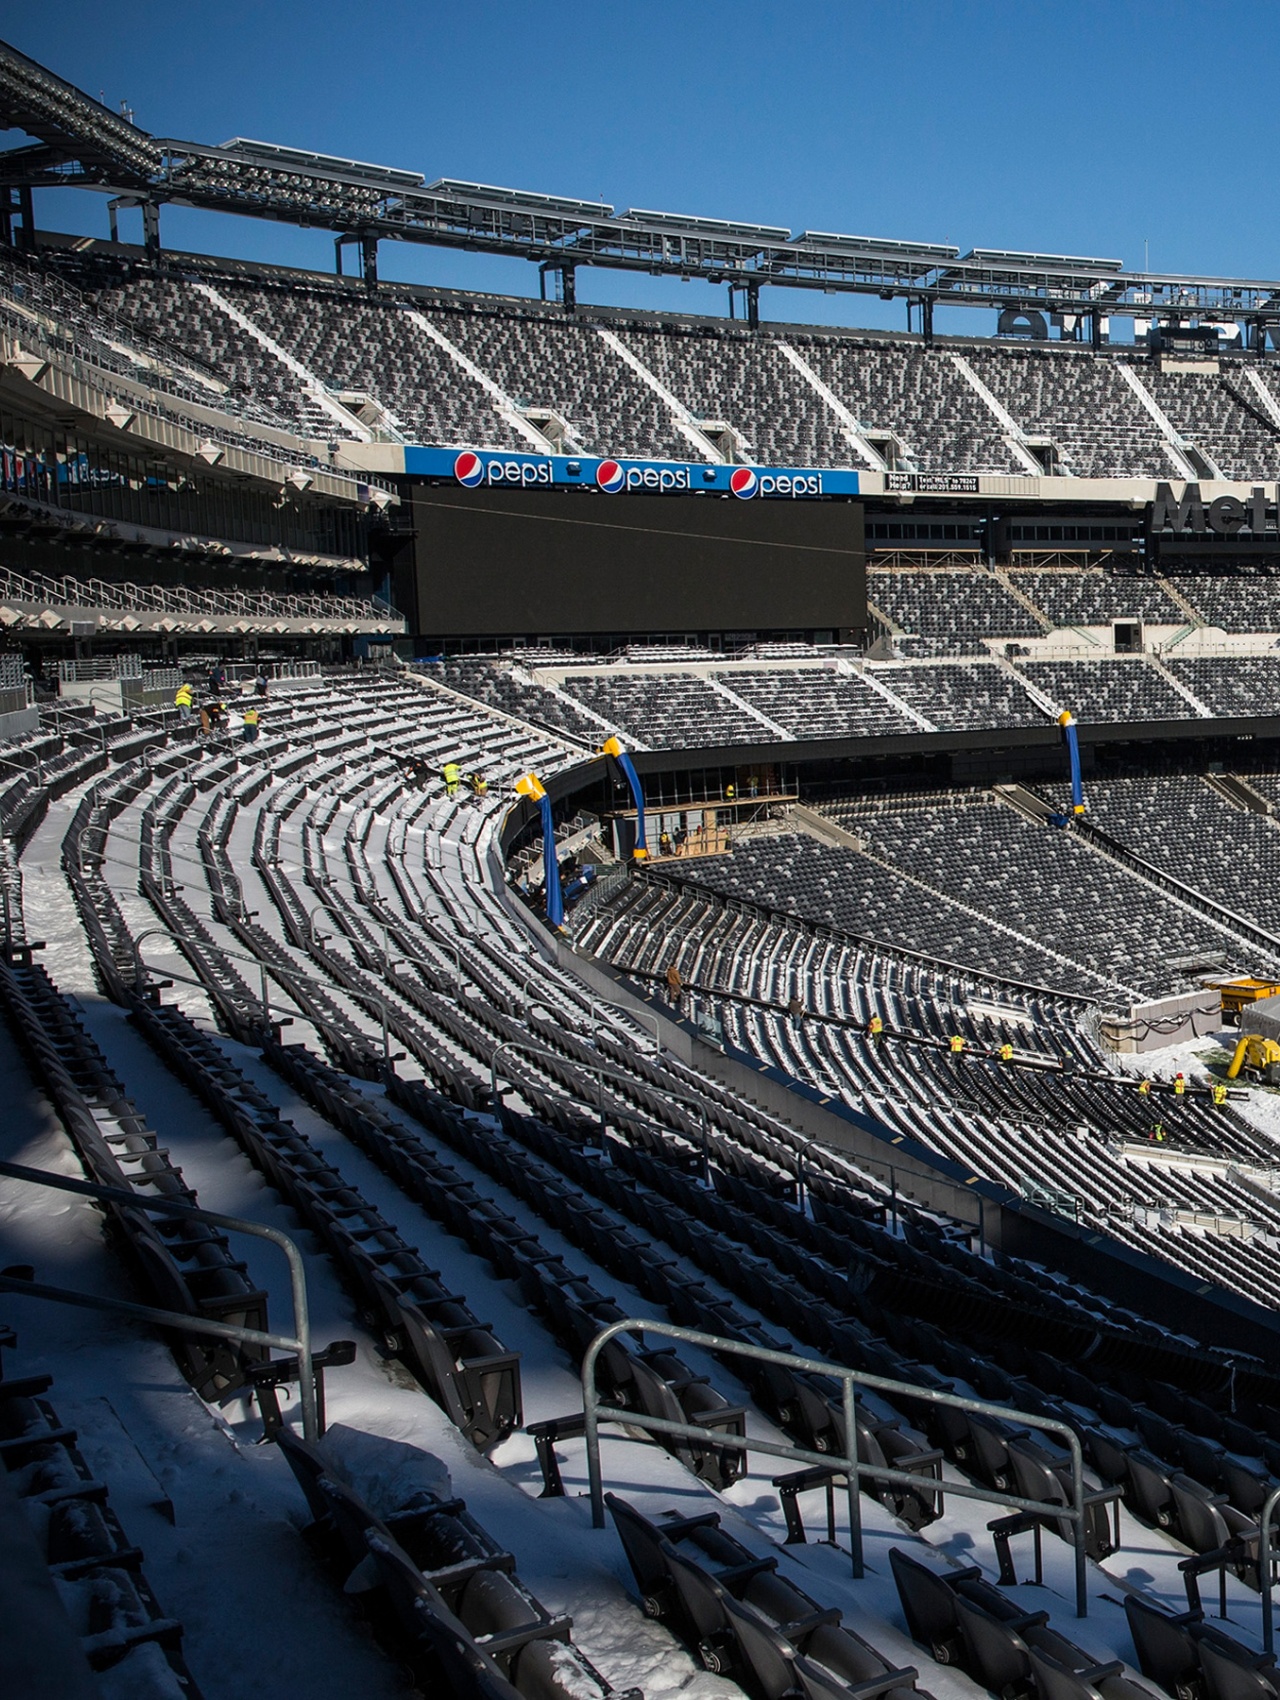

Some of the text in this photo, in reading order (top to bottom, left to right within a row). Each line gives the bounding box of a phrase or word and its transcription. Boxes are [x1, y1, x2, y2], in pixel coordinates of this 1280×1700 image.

[486, 460, 554, 487] pepsi
[626, 466, 691, 493] pepsi
[759, 473, 822, 498] pepsi
[889, 474, 909, 482] Need
